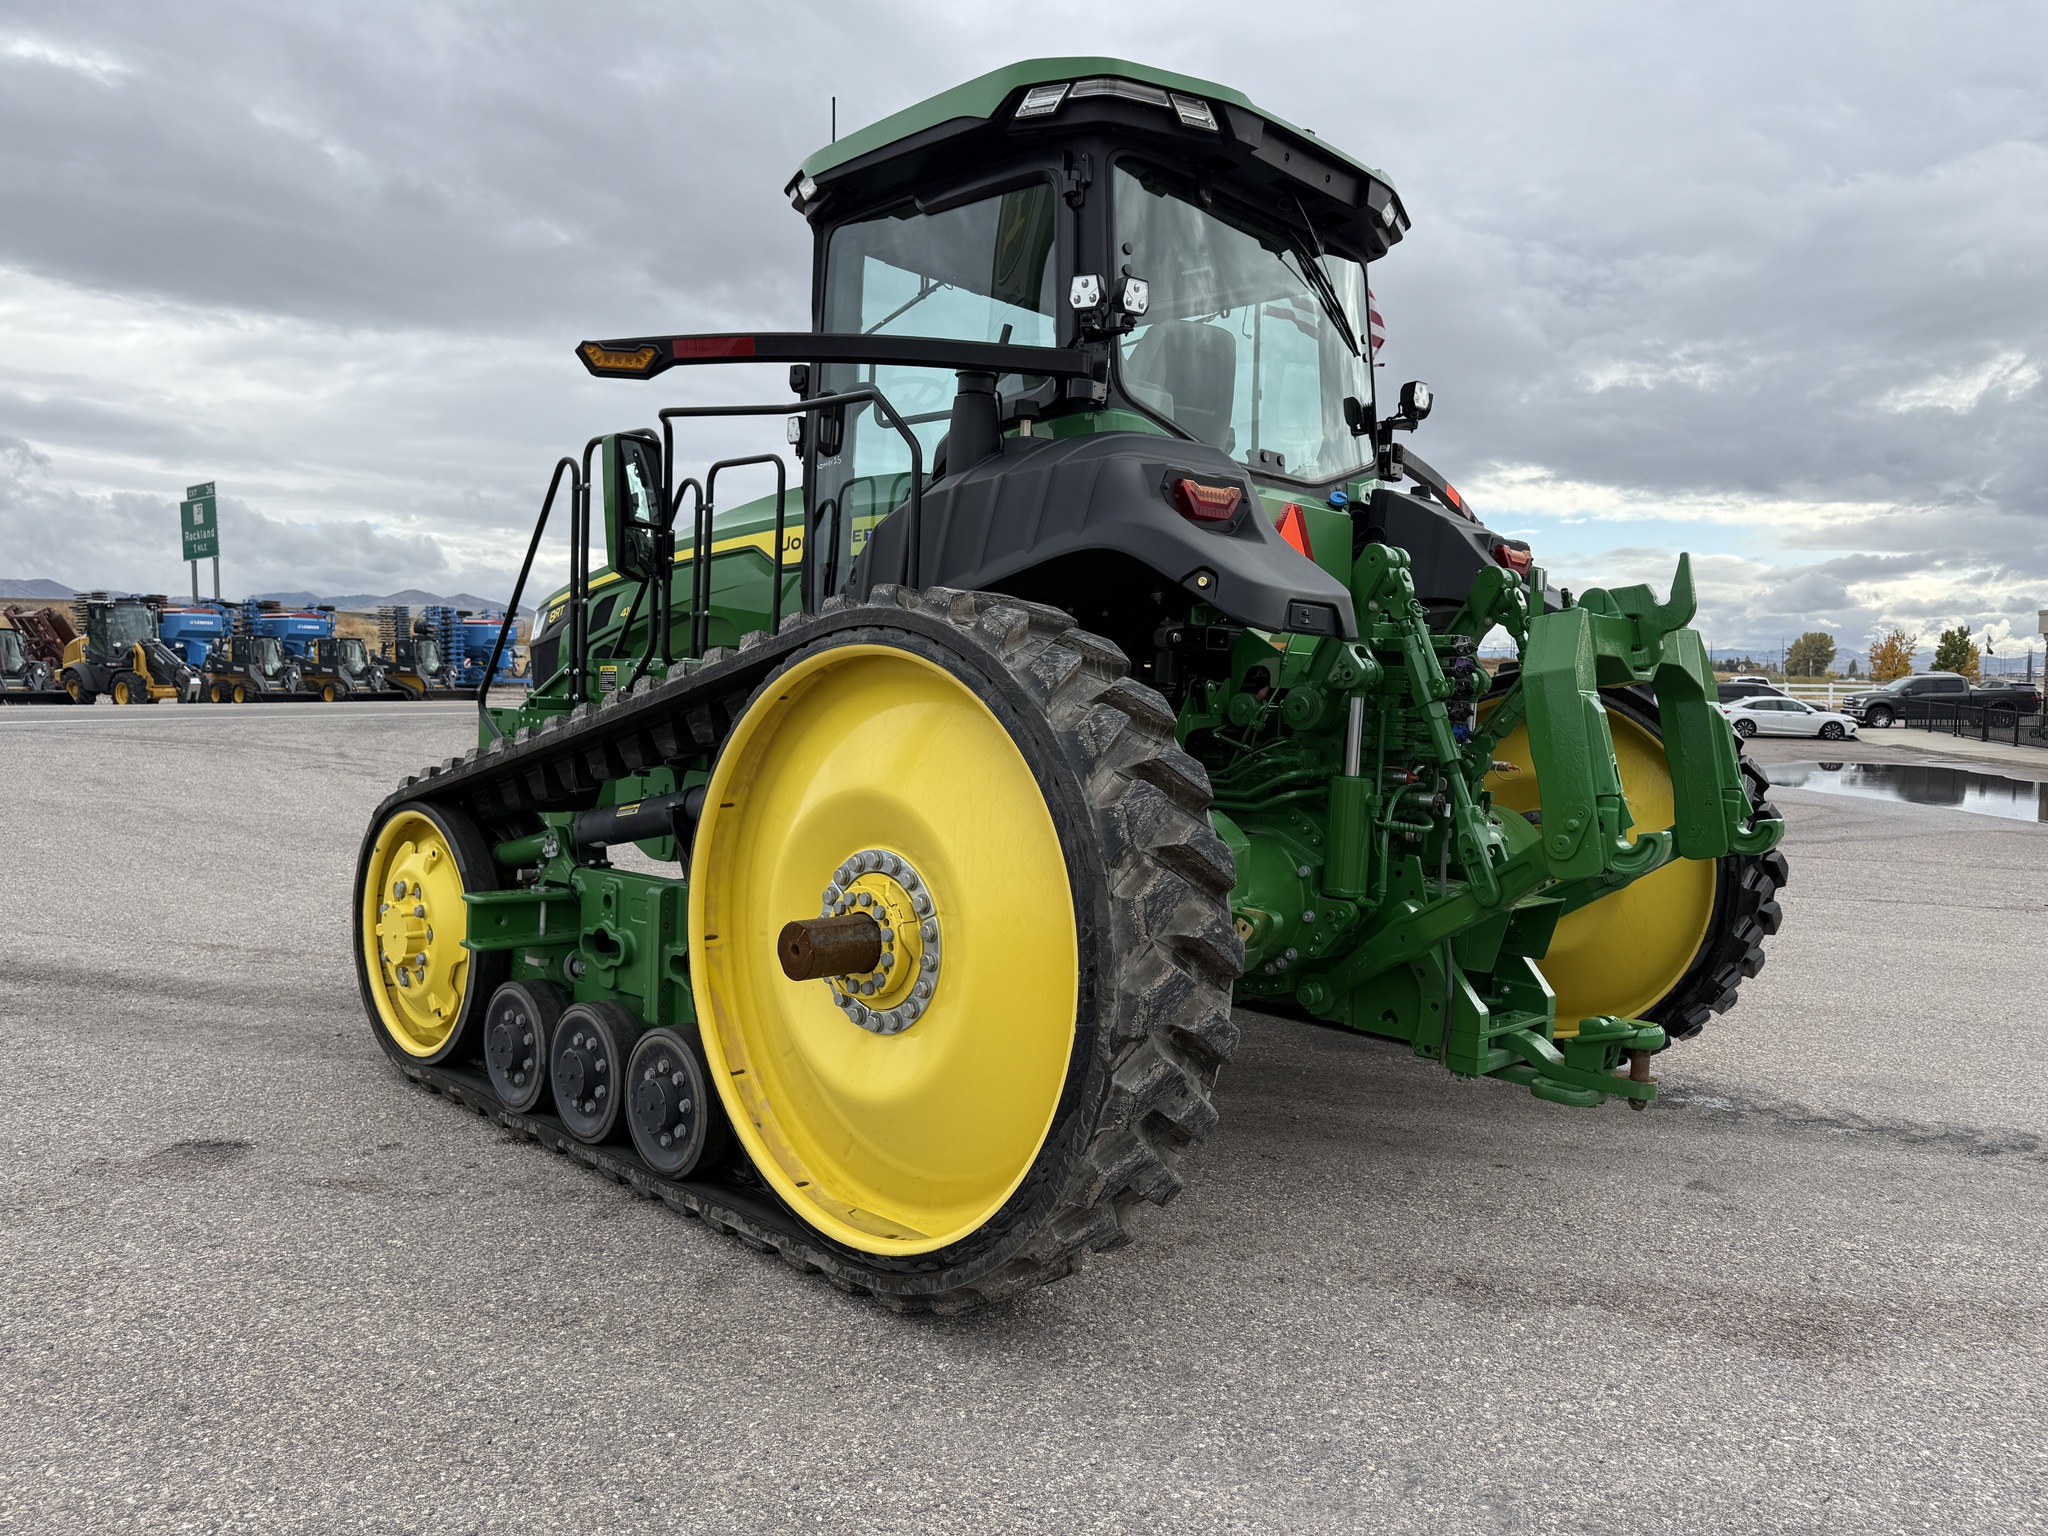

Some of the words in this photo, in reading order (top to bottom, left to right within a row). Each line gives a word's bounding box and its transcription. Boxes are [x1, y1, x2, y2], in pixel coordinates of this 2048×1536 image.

[189, 489, 197, 497] EXIT
[206, 485, 213, 494] 36
[185, 527, 215, 541] Rockland
[549, 604, 565, 623] 8RT
